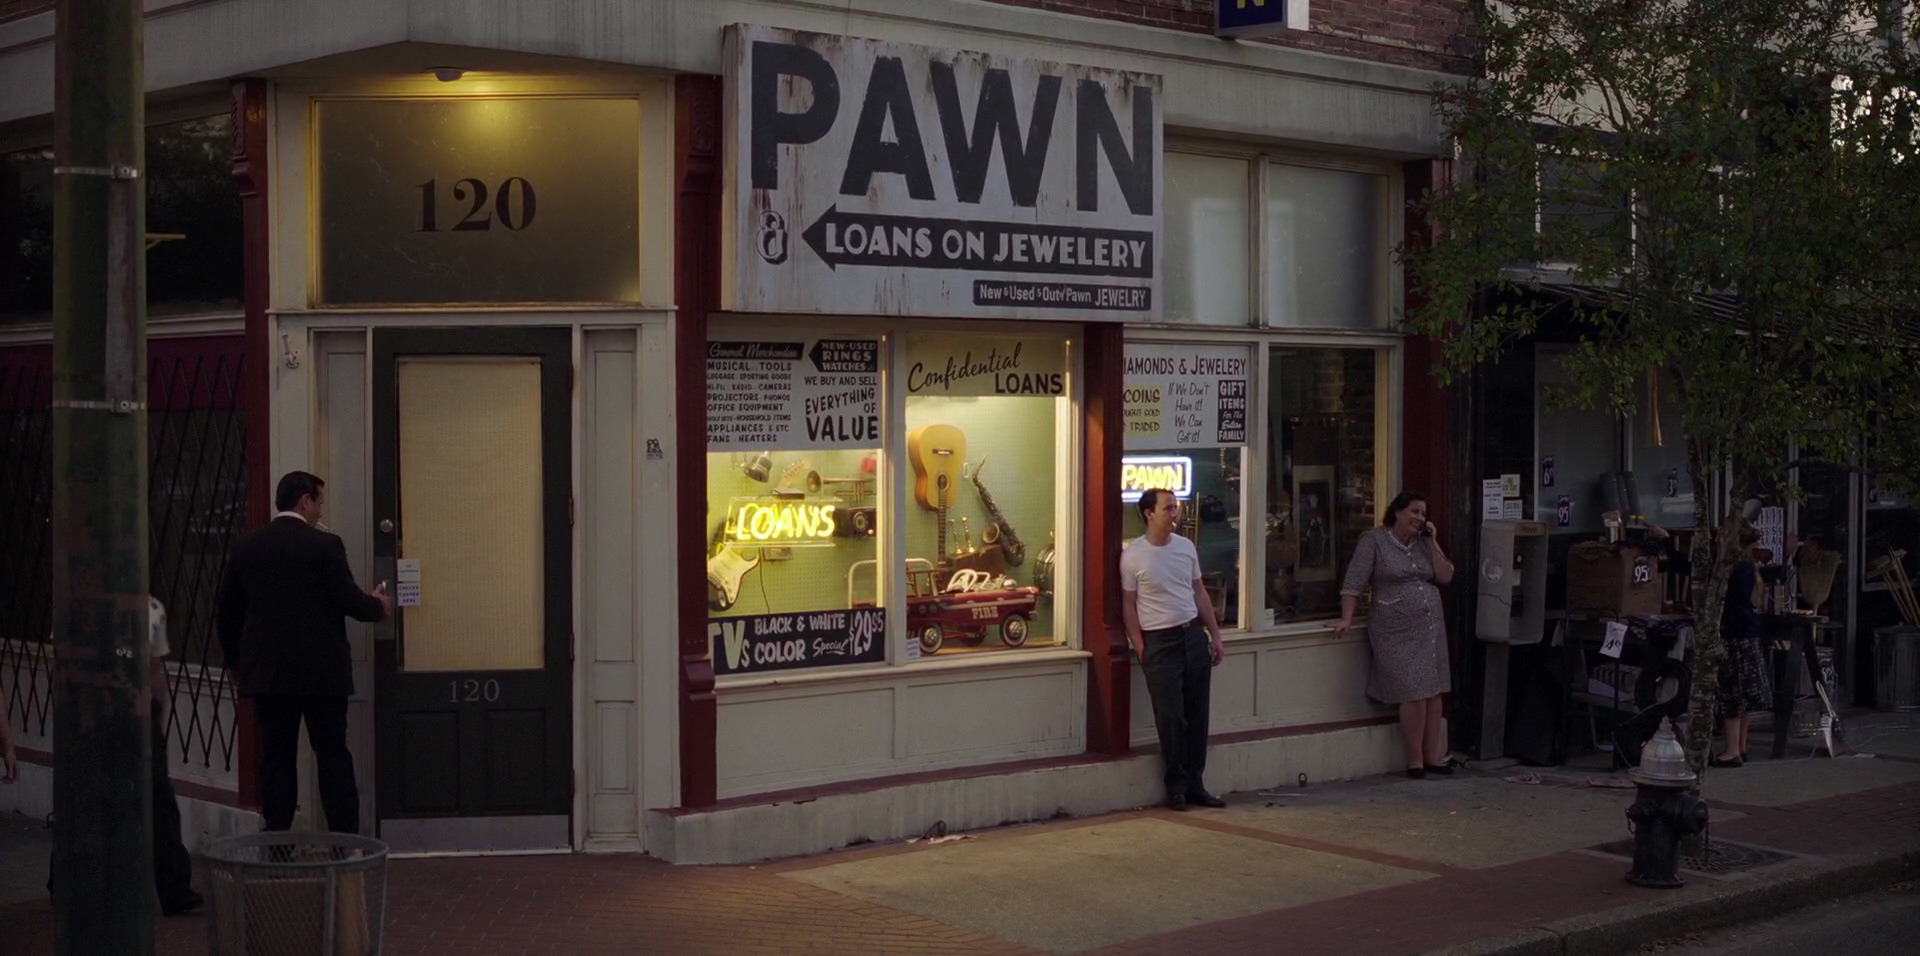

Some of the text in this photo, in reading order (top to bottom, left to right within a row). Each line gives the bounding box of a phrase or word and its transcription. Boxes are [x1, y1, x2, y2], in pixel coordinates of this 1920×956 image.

[751, 40, 1154, 216] PAWN
[414, 176, 537, 232] 120
[756, 209, 788, 265] &
[825, 222, 1147, 269] LOANS ON JEWELERY
[979, 284, 1002, 300] New
[1009, 285, 1035, 300] Used
[1066, 288, 1092, 303] Pawn
[1095, 288, 1146, 307] JEWELRY
[821, 350, 872, 362] RINGS
[707, 361, 792, 372] MUSICAL TOOLS
[821, 362, 867, 372] WATCHES
[907, 341, 1023, 392] Confidential
[1123, 354, 1247, 375] IAMONDS & JEWELERY
[732, 383, 752, 391] RADIO
[758, 383, 792, 391] CAMERAS
[804, 376, 877, 386] WE BUY AND SELL
[995, 373, 1063, 395] LOANS
[1176, 382, 1187, 395] We
[1189, 381, 1210, 396] Don't
[1219, 381, 1245, 396] GIFT
[706, 393, 791, 402] PROJECTORS PHONOS
[805, 387, 875, 415] EVERYTHING
[1123, 388, 1160, 403] COINS
[706, 403, 784, 411] OFFICE EQUIPMENT
[863, 403, 877, 414] OF
[1175, 397, 1193, 411] Have
[1218, 397, 1245, 410] ITEMS
[1130, 422, 1160, 432] TRADED
[1174, 413, 1203, 427] We Can
[707, 424, 763, 433] APPLIANCES
[806, 415, 878, 442] VALUE
[1218, 429, 1245, 441] FAMILY
[706, 434, 777, 443] FANS HEATERS
[1121, 463, 1183, 491] PAWN
[736, 504, 836, 541] LOANS
[971, 605, 999, 620] FIRE
[754, 612, 846, 635] BLACK & WHITE
[754, 637, 849, 664] COLOR Special
[449, 677, 500, 703] 120
